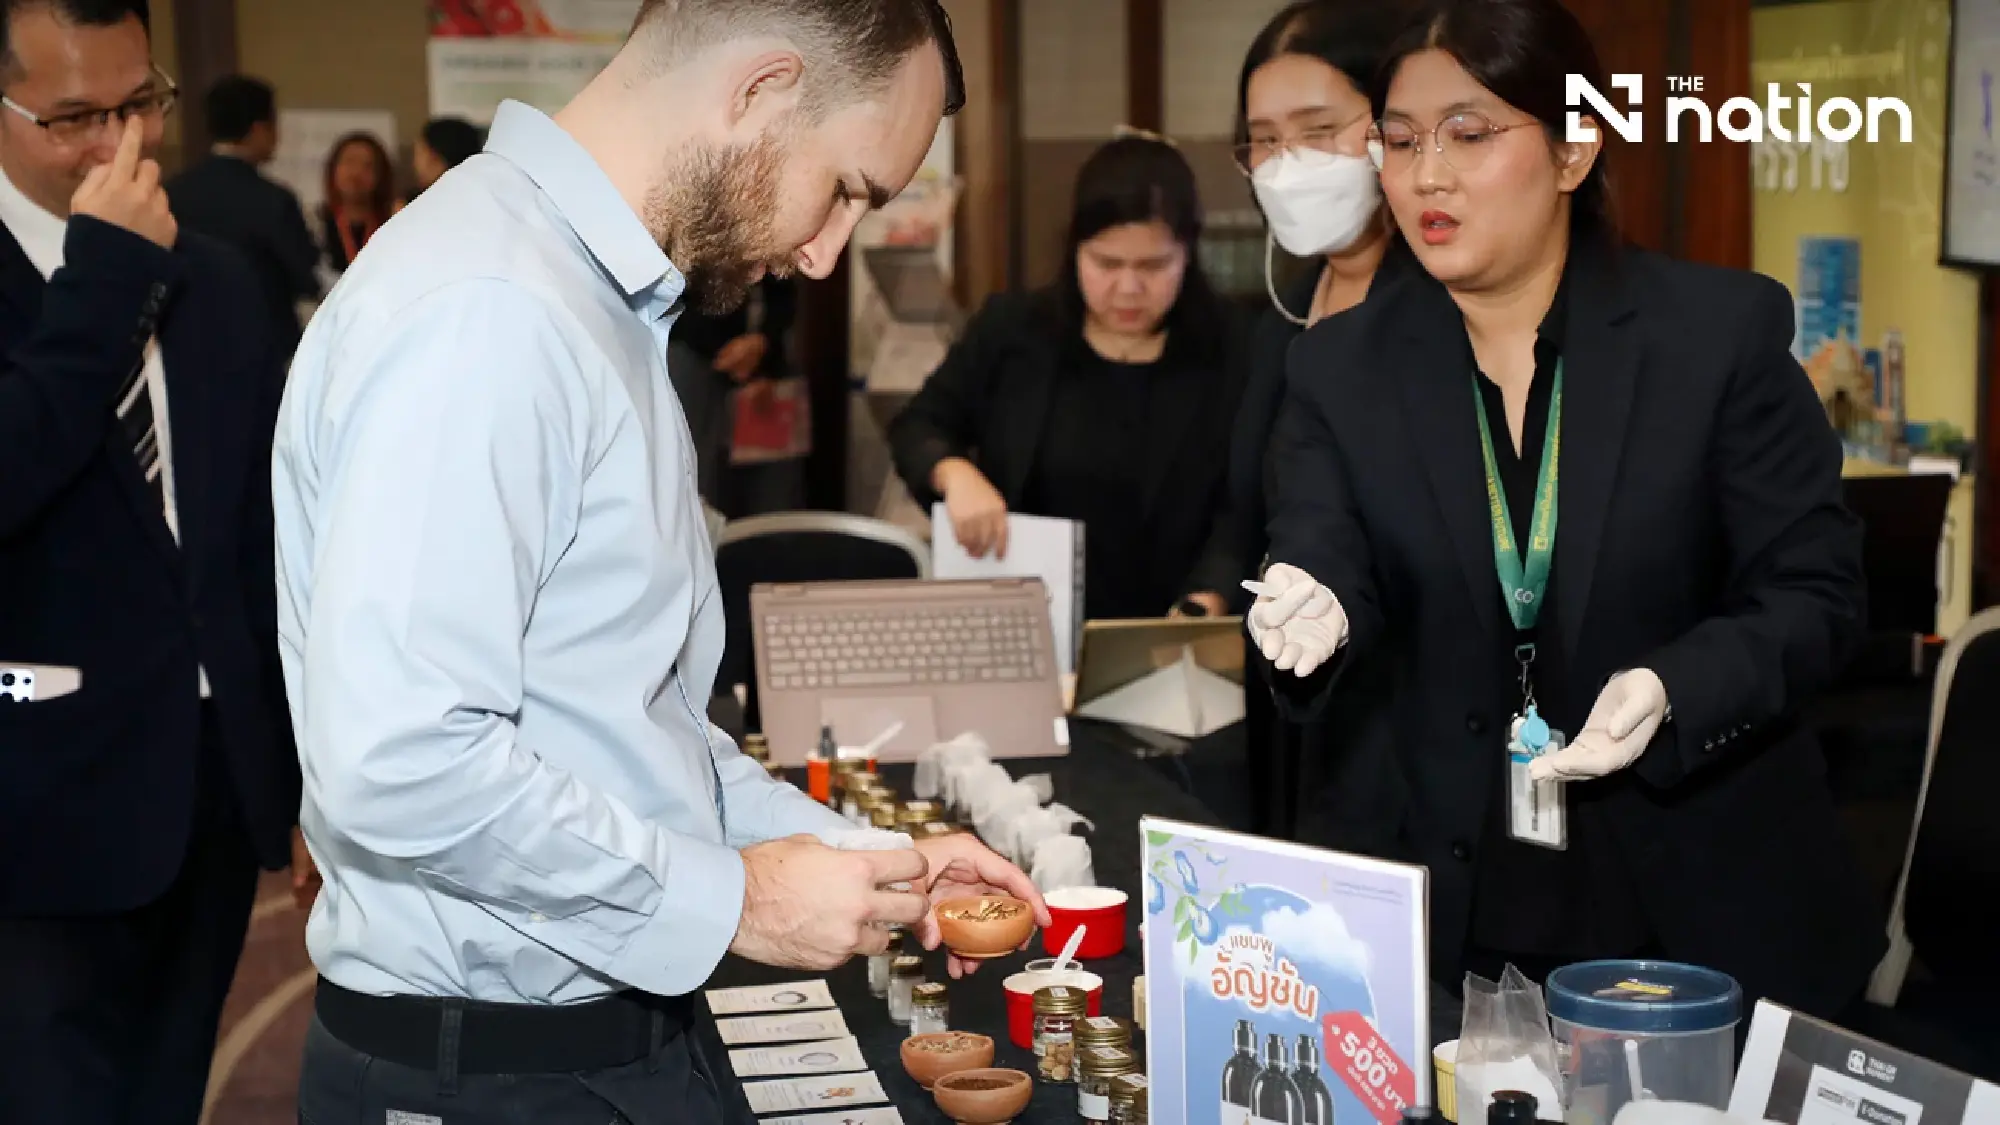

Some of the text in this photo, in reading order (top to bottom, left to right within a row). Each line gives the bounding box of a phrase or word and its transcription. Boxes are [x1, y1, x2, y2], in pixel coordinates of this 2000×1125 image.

[1211, 950, 1315, 1018] อัญชัน
[1340, 1030, 1387, 1088] 500
